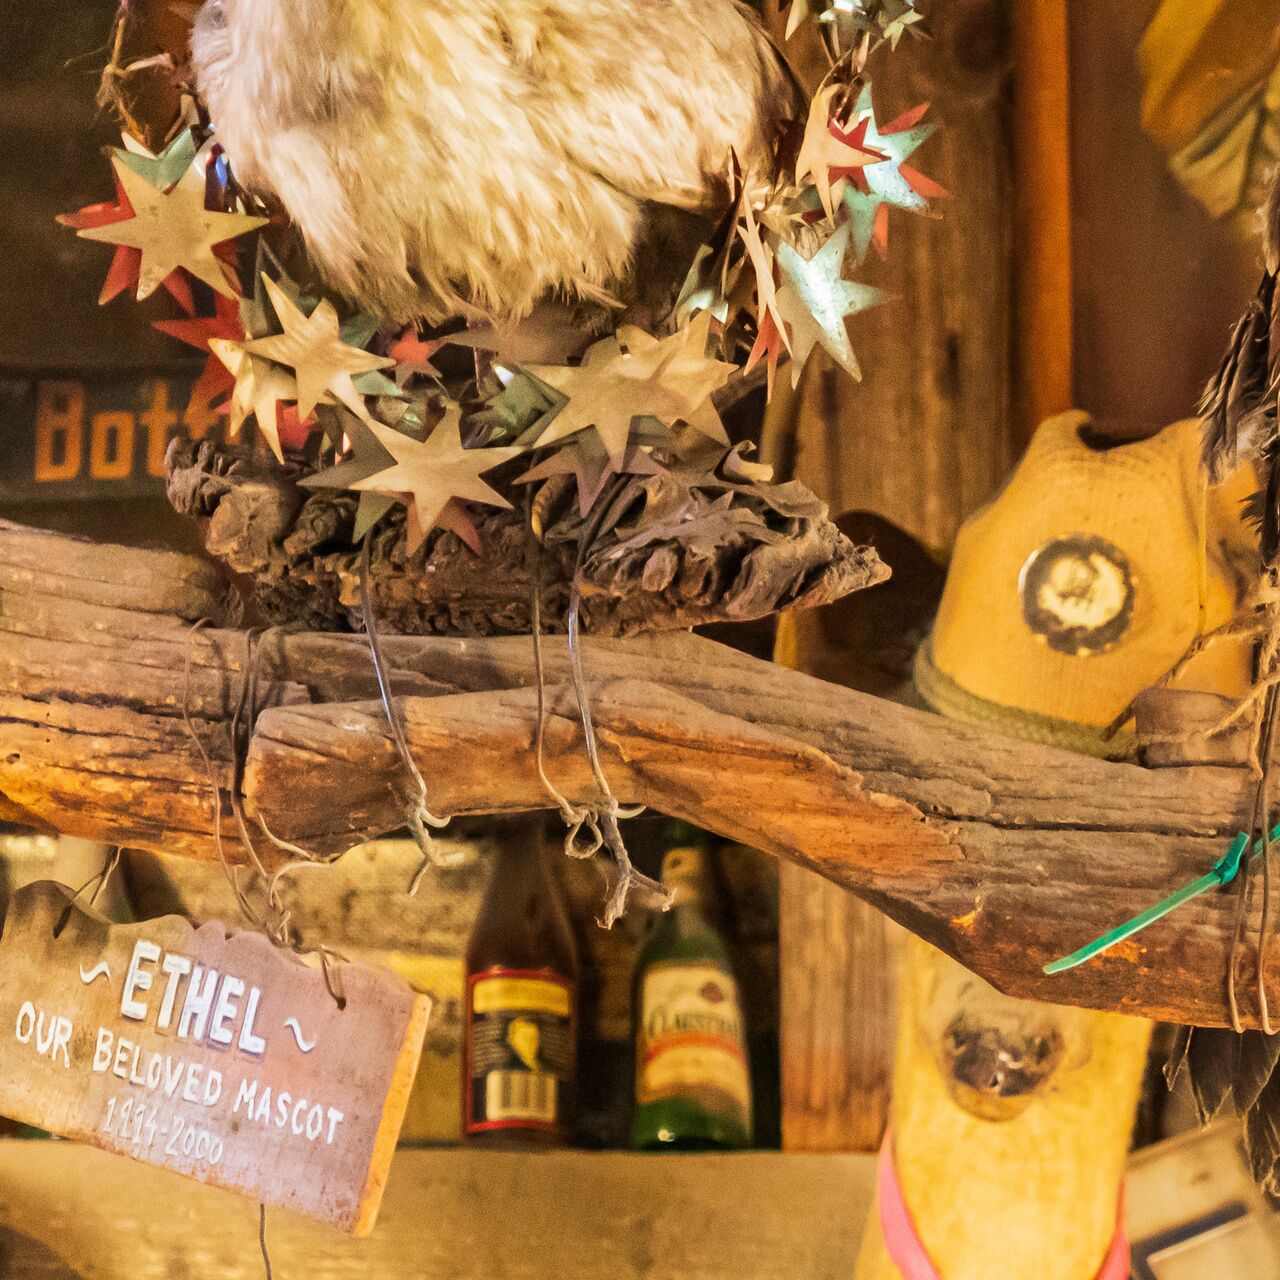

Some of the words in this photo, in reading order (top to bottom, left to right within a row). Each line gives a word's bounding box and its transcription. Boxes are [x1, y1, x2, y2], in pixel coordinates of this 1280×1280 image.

[120, 940, 266, 1054] ETHEL
[15, 1002, 73, 1068] OUR
[93, 1027, 223, 1108] BELOVED
[233, 1080, 345, 1146] MASCOT
